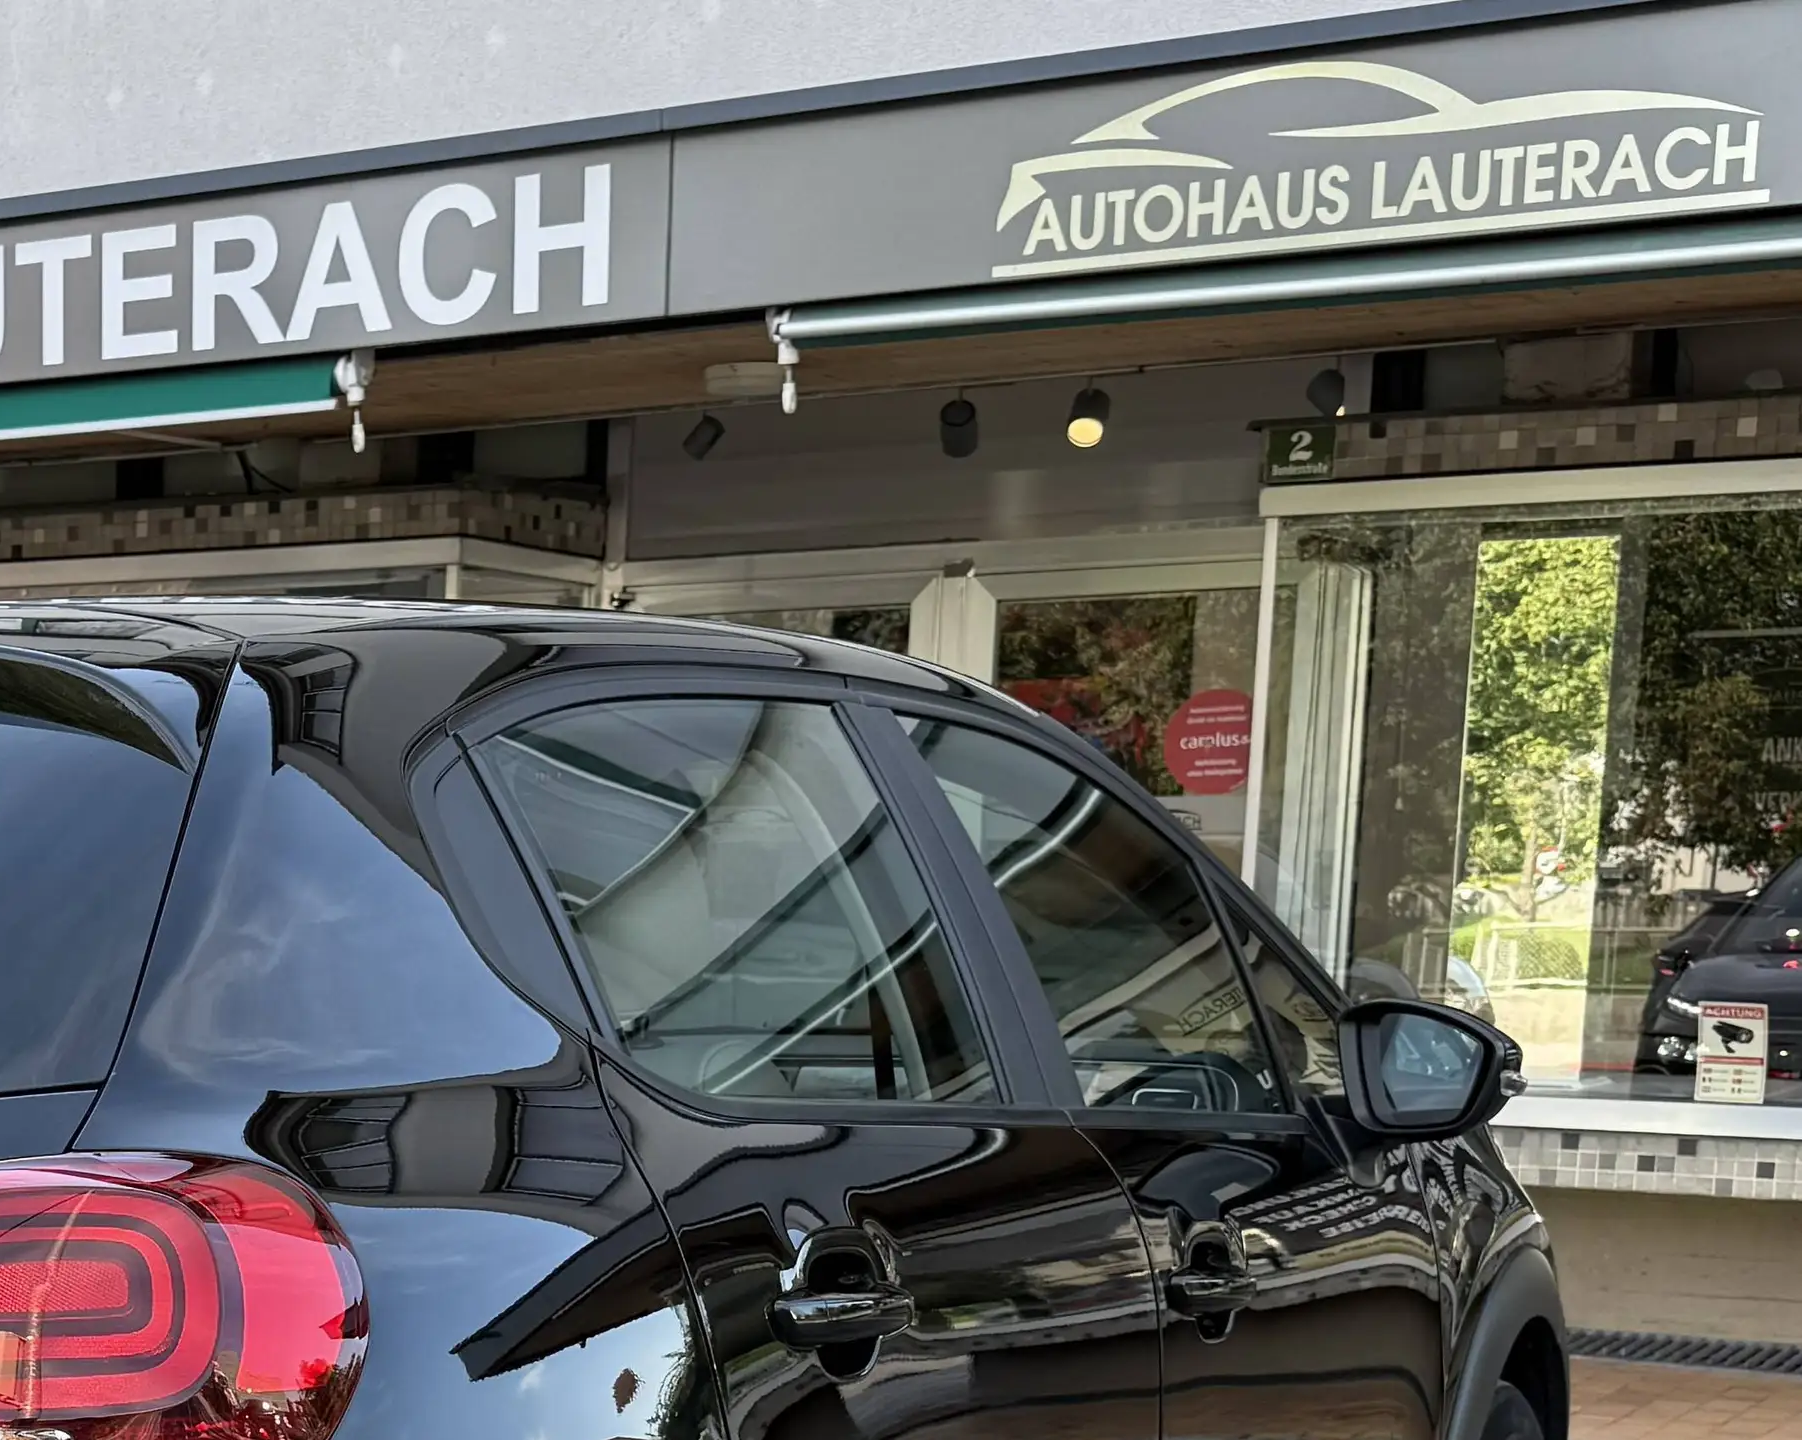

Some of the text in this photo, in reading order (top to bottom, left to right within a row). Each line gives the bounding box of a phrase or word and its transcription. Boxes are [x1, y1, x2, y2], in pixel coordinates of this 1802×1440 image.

[1022, 120, 1762, 256] AUTOHAUS LAUTERACH
[1289, 430, 1313, 462] 2
[1704, 1007, 1762, 1018] ACHTUNG
